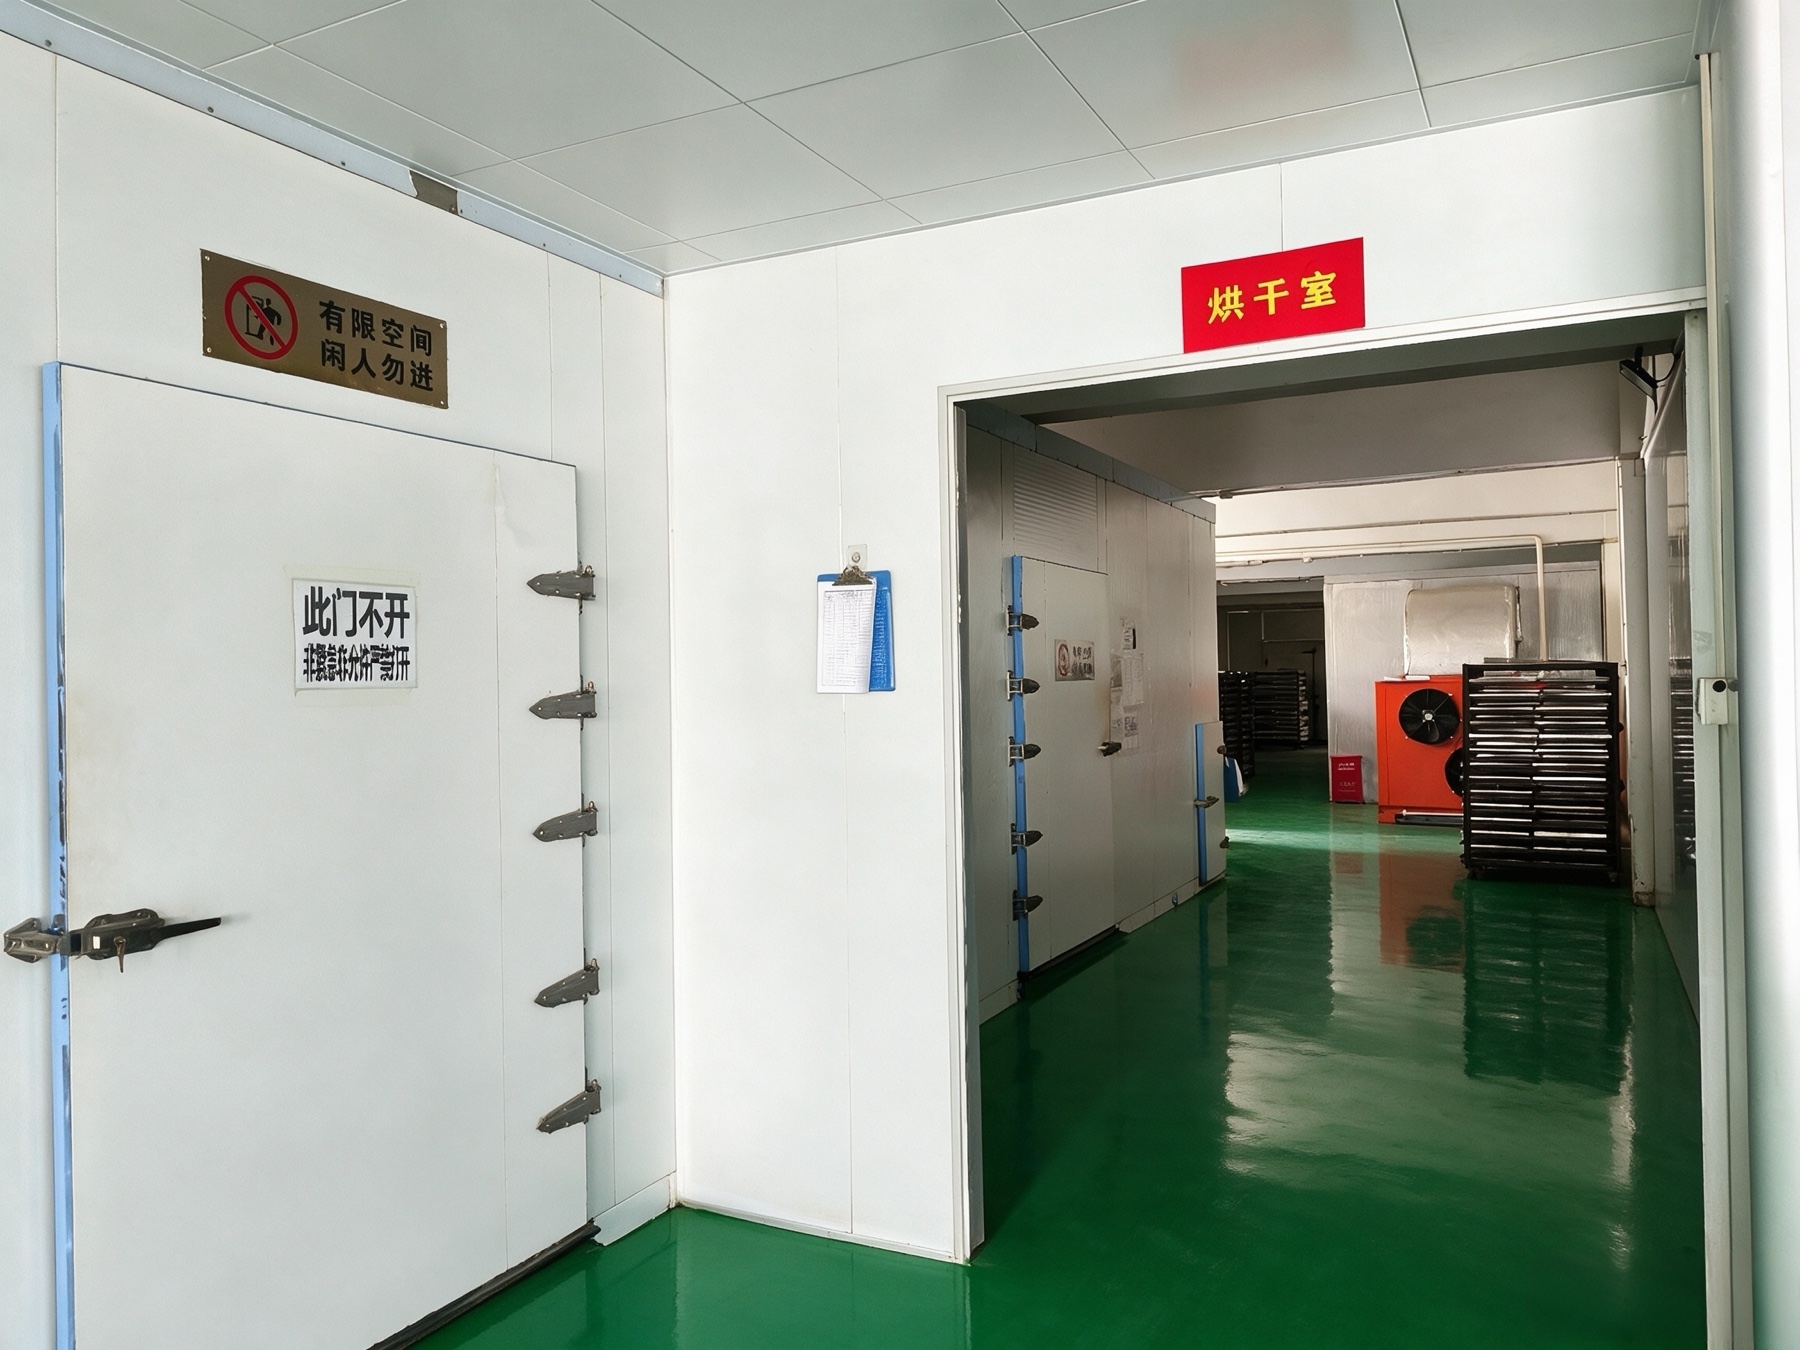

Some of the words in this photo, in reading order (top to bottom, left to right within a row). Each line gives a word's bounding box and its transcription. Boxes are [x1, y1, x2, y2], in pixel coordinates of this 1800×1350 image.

[1207, 270, 1336, 324] 烘干室
[319, 300, 432, 357] 有限空间
[321, 338, 433, 392] 闲人勿进
[302, 586, 410, 639] 此门不开
